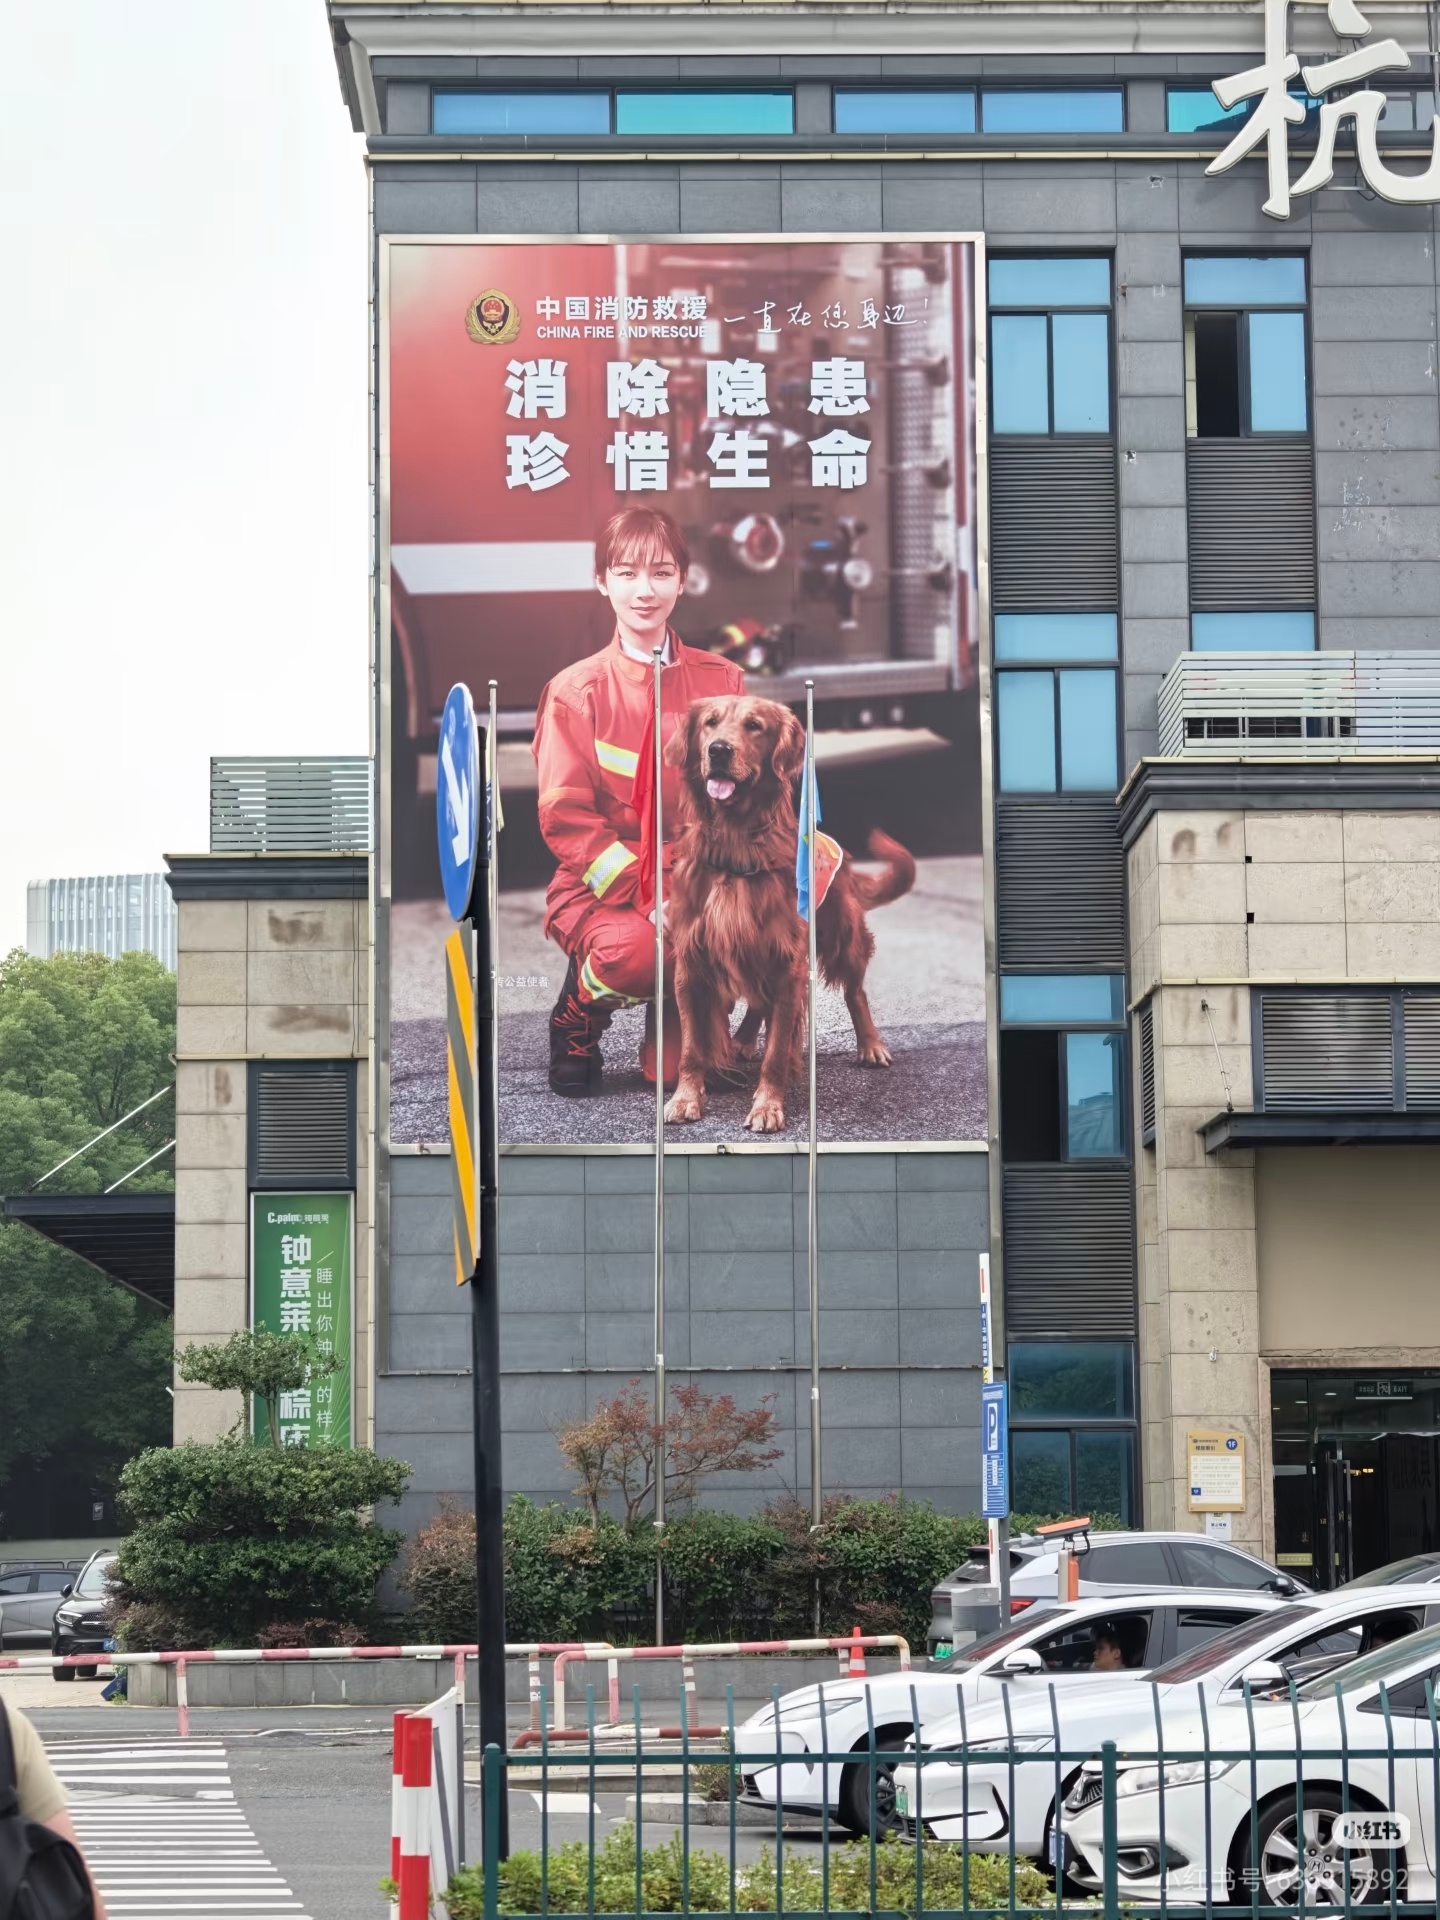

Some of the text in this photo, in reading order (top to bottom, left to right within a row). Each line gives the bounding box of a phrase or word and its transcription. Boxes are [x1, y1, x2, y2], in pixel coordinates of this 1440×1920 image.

[536, 296, 708, 321] 中国消防救援
[537, 325, 708, 339] CHINA FIRE AND RESCUE
[505, 357, 871, 419] 消除隐患
[506, 429, 872, 492] 珍惜生命
[280, 1234, 312, 1332] 钟意莱
